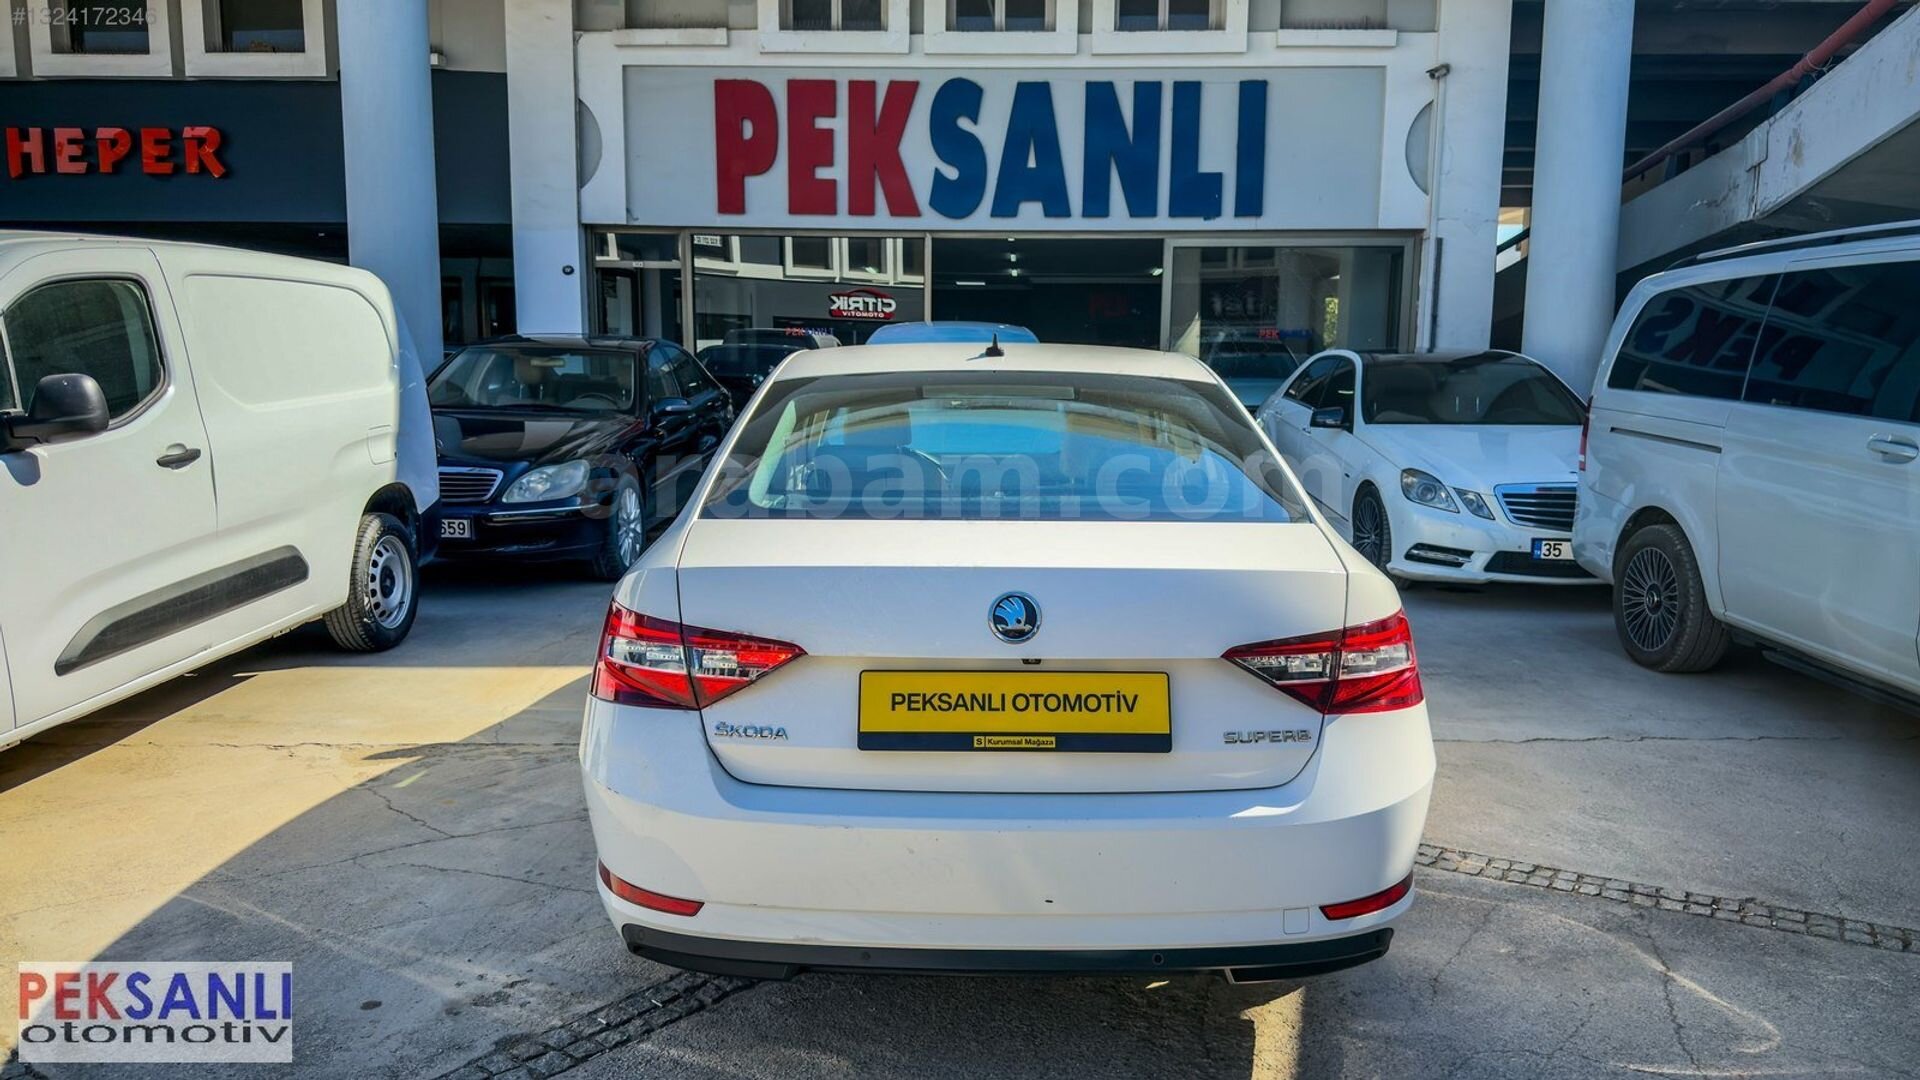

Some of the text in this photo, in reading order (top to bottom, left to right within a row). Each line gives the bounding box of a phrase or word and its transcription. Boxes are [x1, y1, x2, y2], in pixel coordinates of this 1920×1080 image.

[6, 126, 227, 179] HEPER
[714, 77, 1268, 219] PEKSANLI
[1542, 542, 1563, 557] 35
[891, 689, 1139, 713] PEKSANLI OTOMOTİV
[714, 721, 789, 740] ŠKODA
[1223, 729, 1312, 744] SUPERB
[976, 737, 1054, 747] S Kurumsal Mağaza
